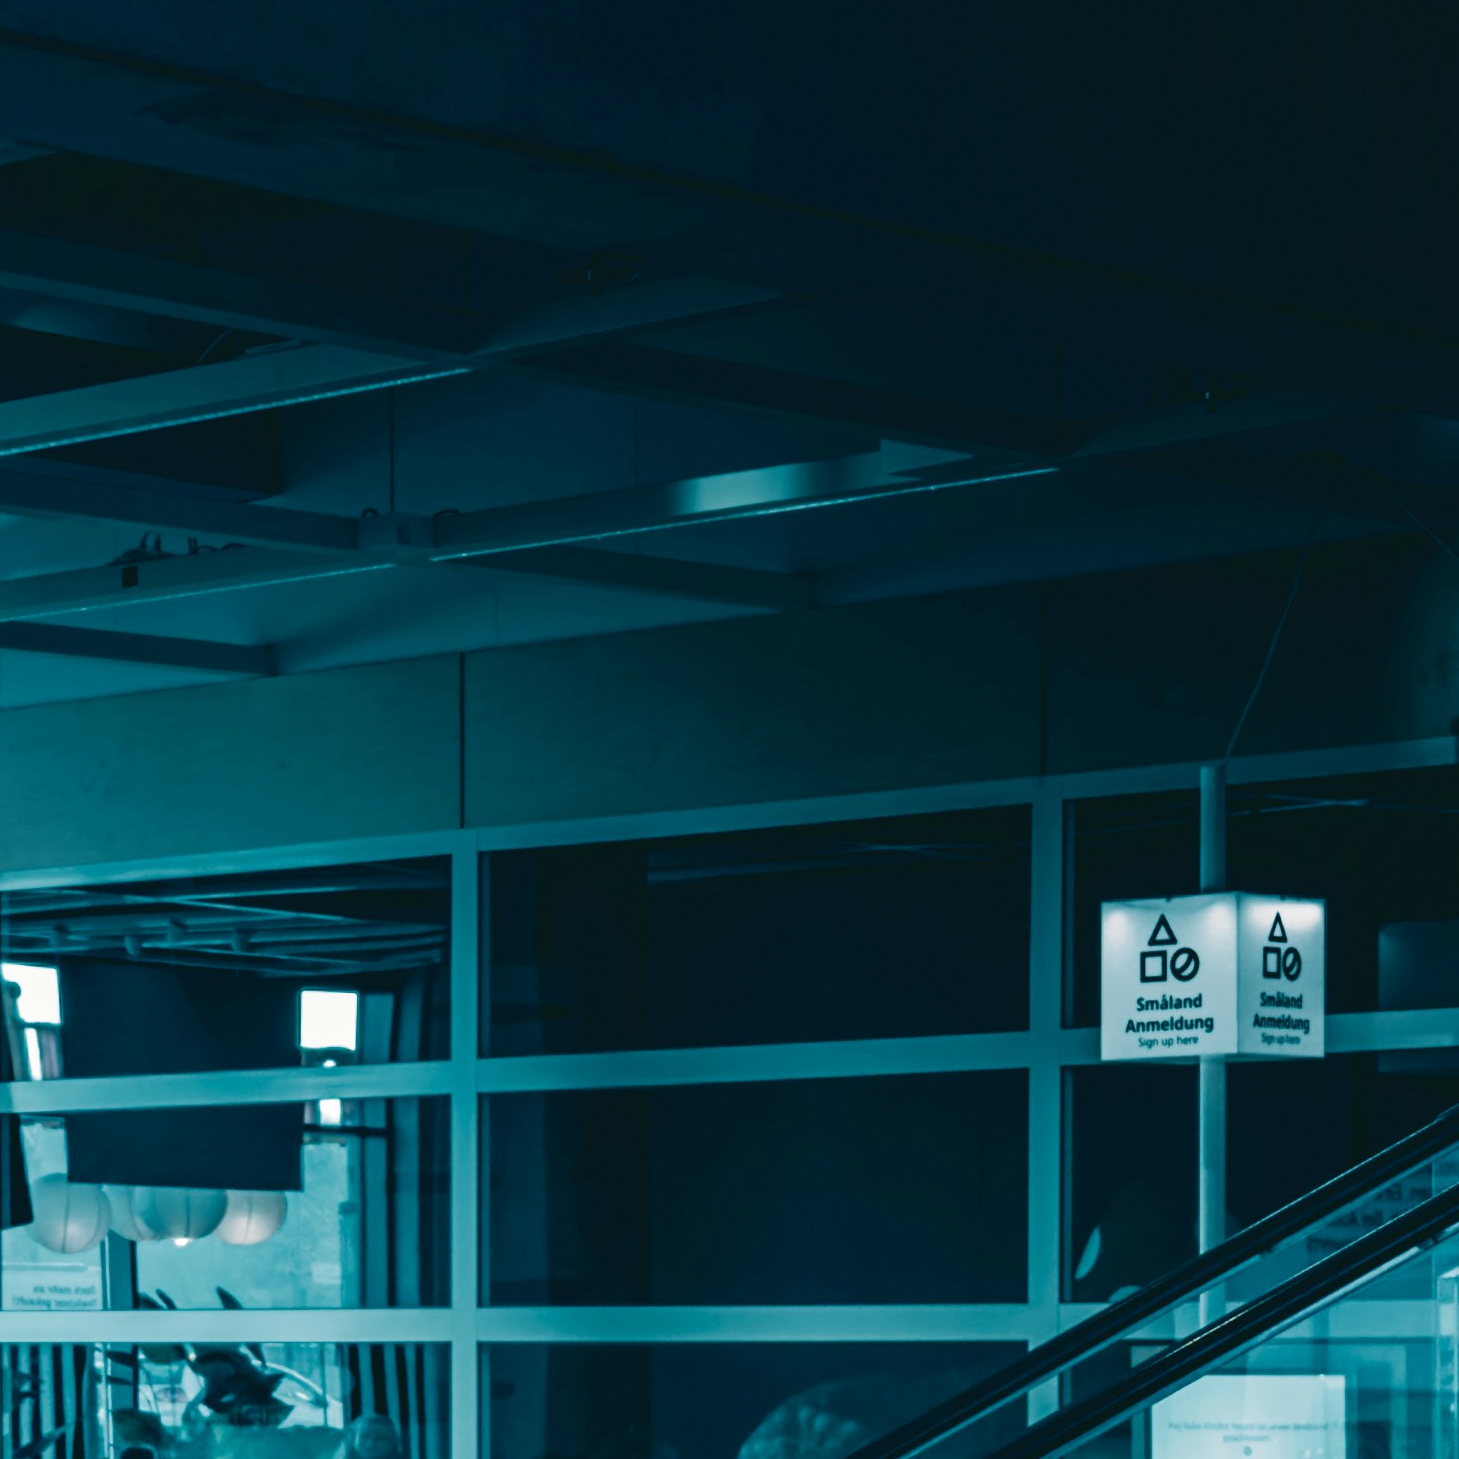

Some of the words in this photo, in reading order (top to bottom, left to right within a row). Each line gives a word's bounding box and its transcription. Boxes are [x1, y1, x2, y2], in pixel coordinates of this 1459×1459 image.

[1137, 993, 1202, 1011] Småland
[1260, 992, 1303, 1009] Småland
[1125, 1016, 1214, 1033] Anmeldung
[1253, 1013, 1310, 1034] Anmeldung
[1138, 1037, 1159, 1049] Sign
[1162, 1038, 1174, 1047] up
[1177, 1035, 1199, 1046] here
